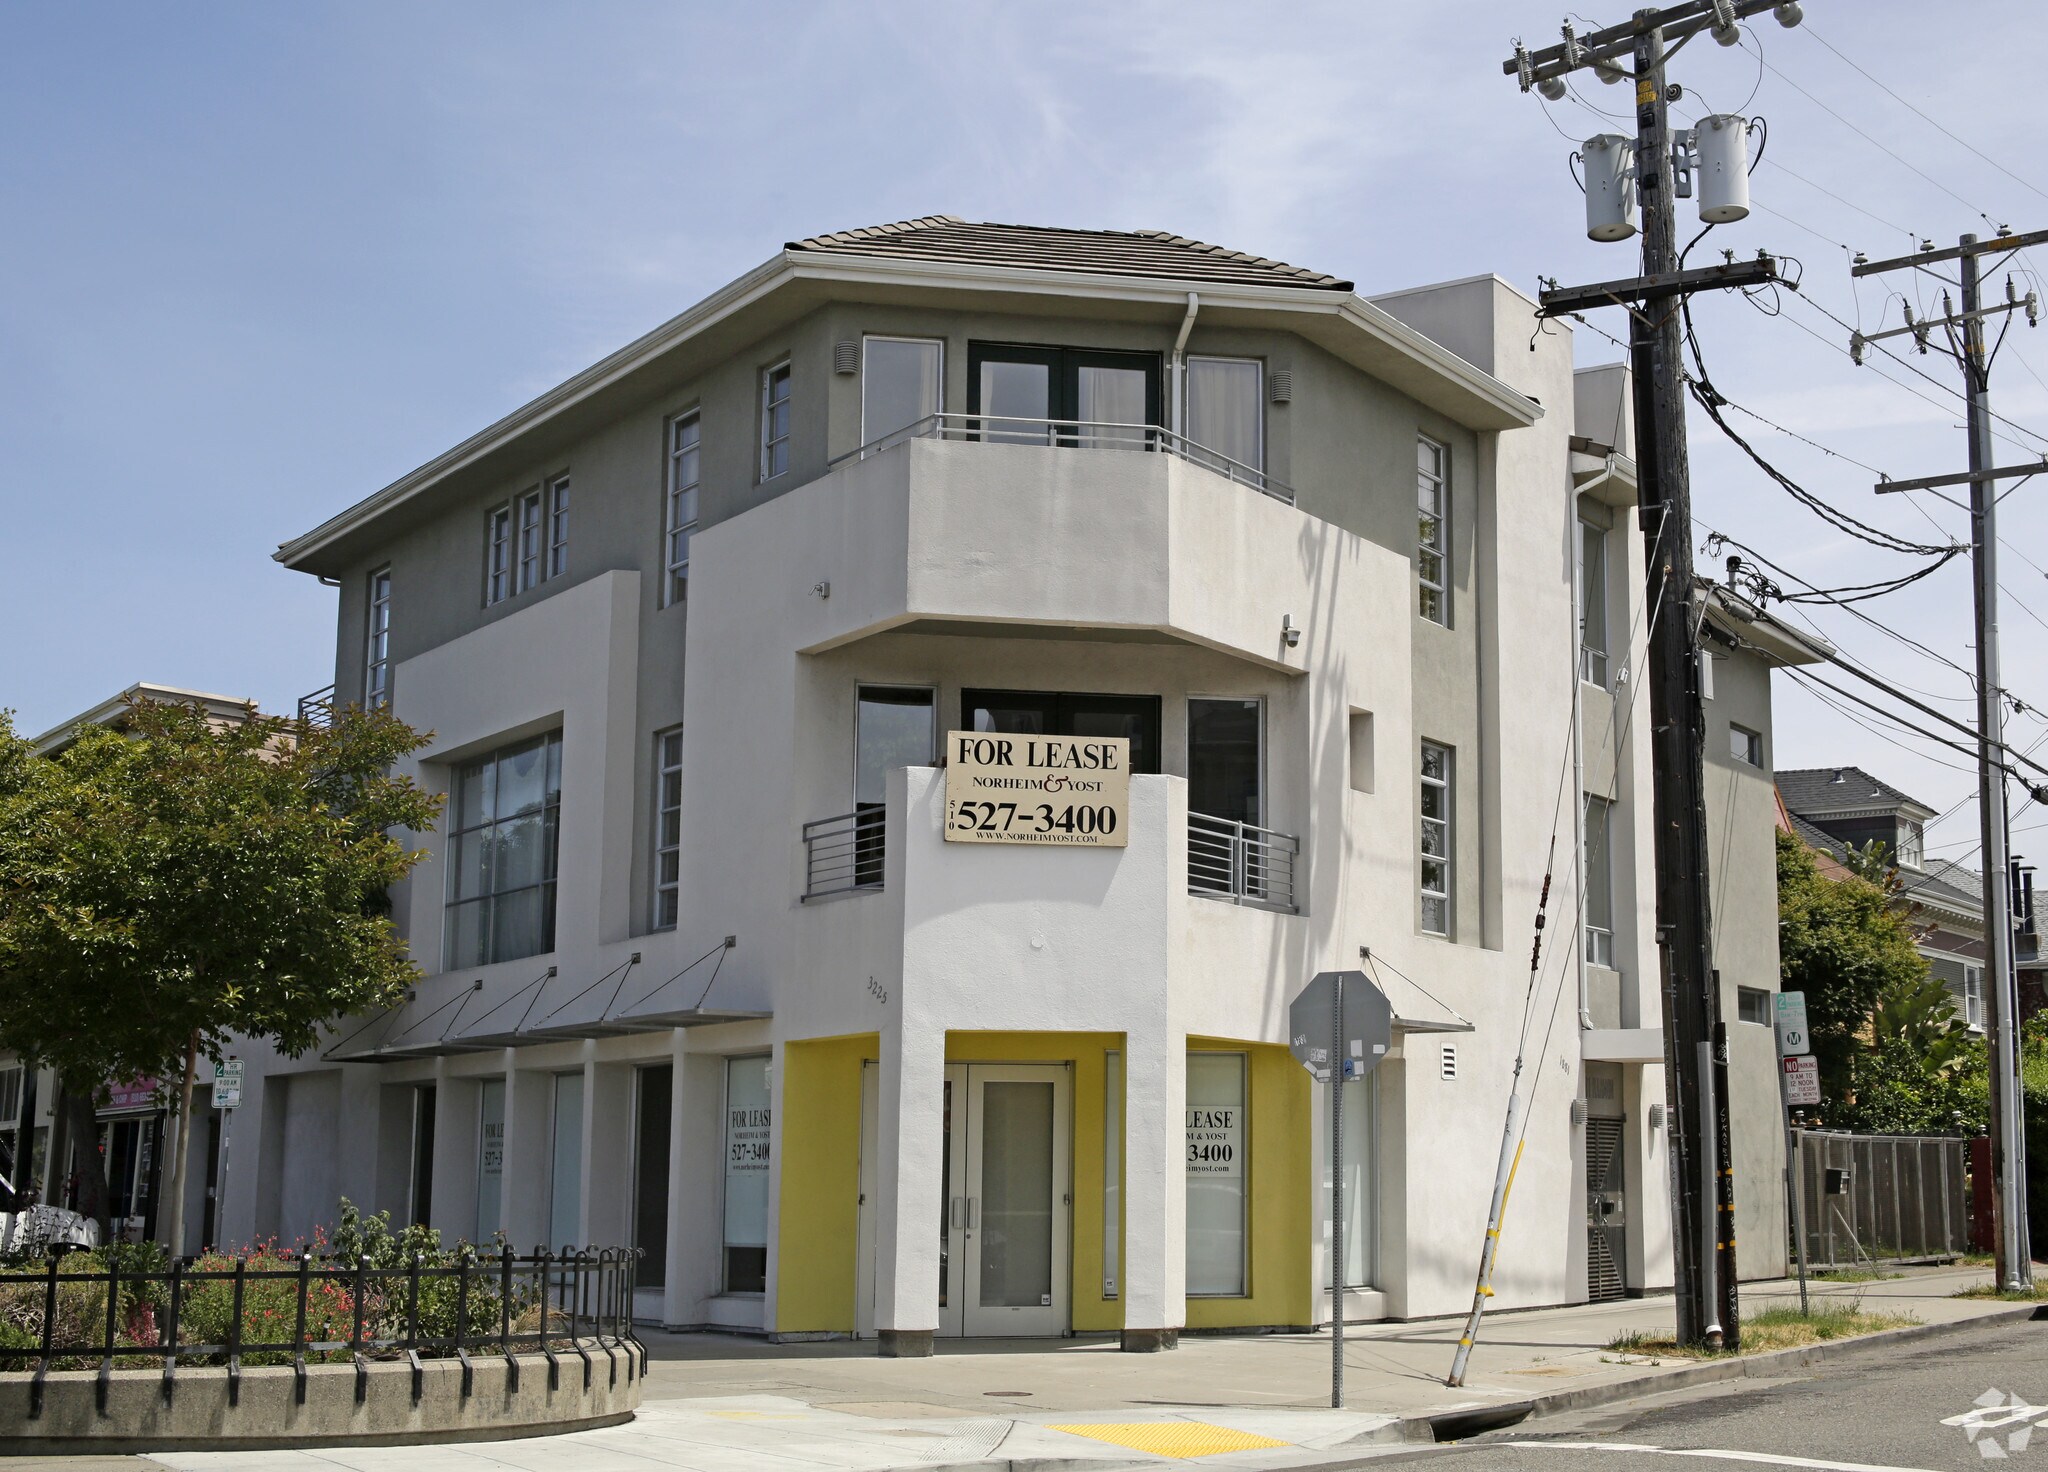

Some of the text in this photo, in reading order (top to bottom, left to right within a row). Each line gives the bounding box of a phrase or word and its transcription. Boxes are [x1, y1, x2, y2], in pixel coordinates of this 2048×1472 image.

[958, 738, 1118, 770] FOR LEASE
[972, 774, 1103, 792] NORHEIM & YOST
[958, 801, 1117, 834] 527-3400
[976, 832, 1098, 842] WWW.NORHEIMYOST.COM
[868, 976, 887, 1004] 3225
[1778, 996, 1786, 1008] 2
[216, 1064, 223, 1076] 2
[1786, 1061, 1797, 1071] NO
[732, 1111, 746, 1128] FOR
[1186, 1111, 1233, 1128] LEASE
[485, 1151, 503, 1166] 527-3
[1188, 1144, 1232, 1162] 3400
[1186, 1164, 1229, 1173] imyost.com
